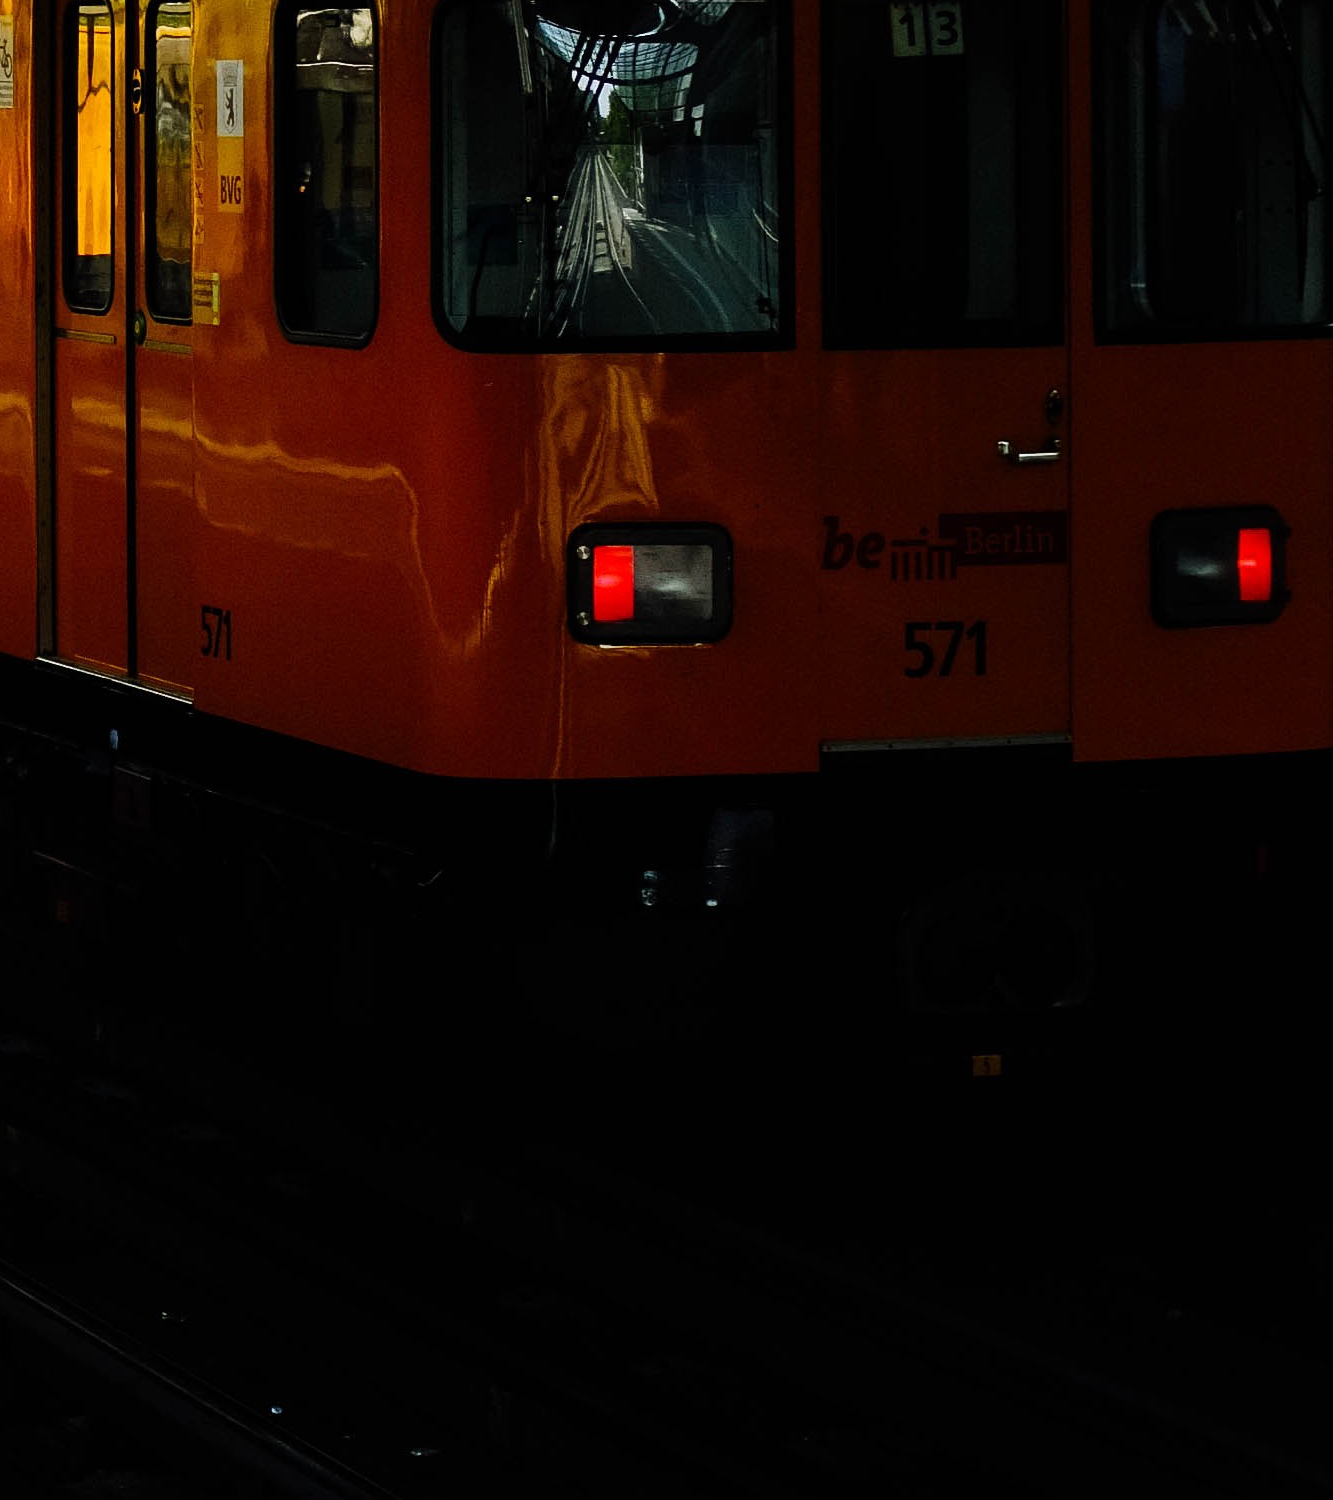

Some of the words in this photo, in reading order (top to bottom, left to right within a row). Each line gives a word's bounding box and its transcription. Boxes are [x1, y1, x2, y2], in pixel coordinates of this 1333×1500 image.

[899, 10, 958, 46] 13
[220, 175, 242, 204] BVG
[821, 516, 886, 570] be
[965, 523, 1054, 554] Berlin
[201, 605, 232, 660] 571
[904, 620, 986, 677] 571
